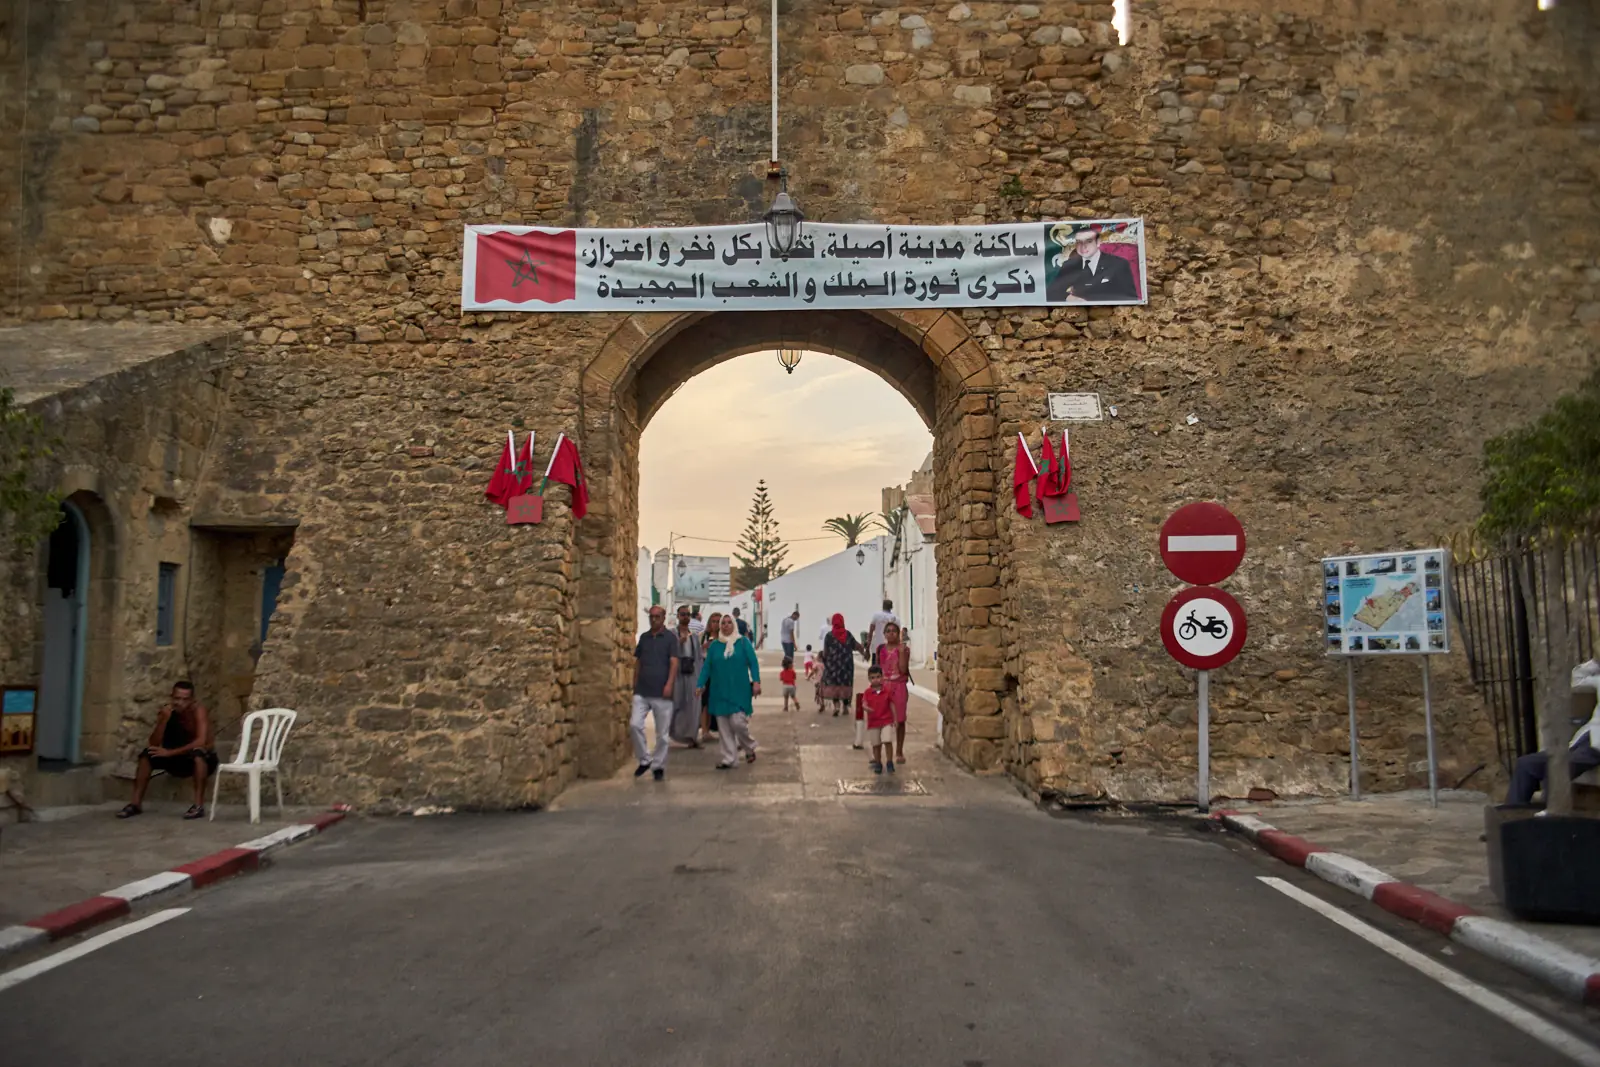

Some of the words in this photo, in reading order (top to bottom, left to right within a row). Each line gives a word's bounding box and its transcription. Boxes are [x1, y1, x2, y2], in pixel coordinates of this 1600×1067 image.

[674, 234, 715, 267] فخر
[722, 232, 762, 266] بكل
[821, 226, 893, 265] أصيلة،
[899, 232, 965, 265] مدينة
[973, 231, 1039, 257] ساكنة
[597, 272, 705, 304] المجيدة
[823, 270, 896, 298] الملك
[903, 268, 960, 302] ثورة
[967, 268, 1036, 301] ذكرى
